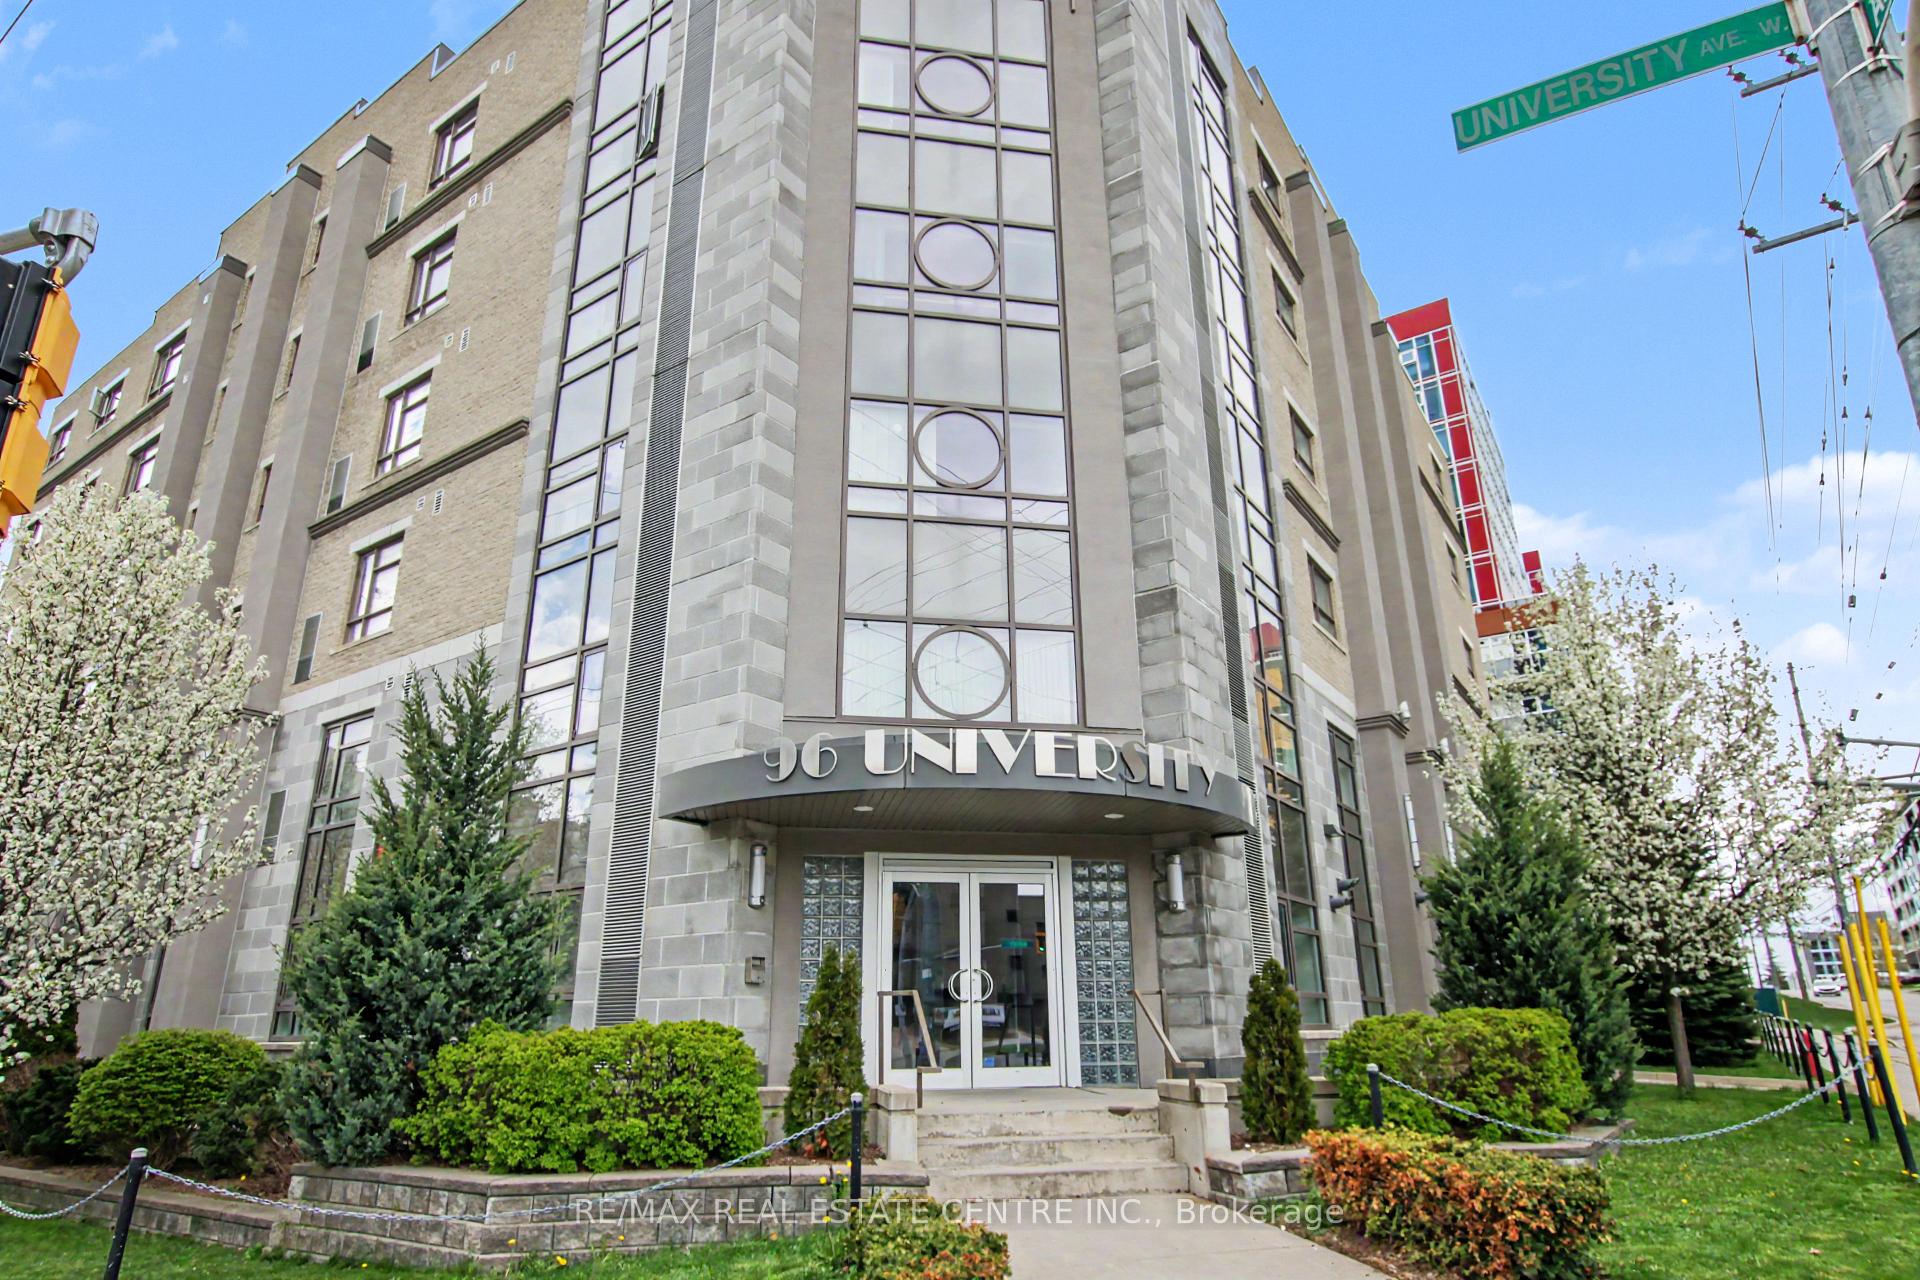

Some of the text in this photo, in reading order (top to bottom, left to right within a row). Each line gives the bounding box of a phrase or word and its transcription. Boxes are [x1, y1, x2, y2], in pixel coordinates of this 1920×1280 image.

[1455, 38, 1688, 144] UNIVERSITY
[763, 727, 1219, 797] 96 UNIVERSITY
